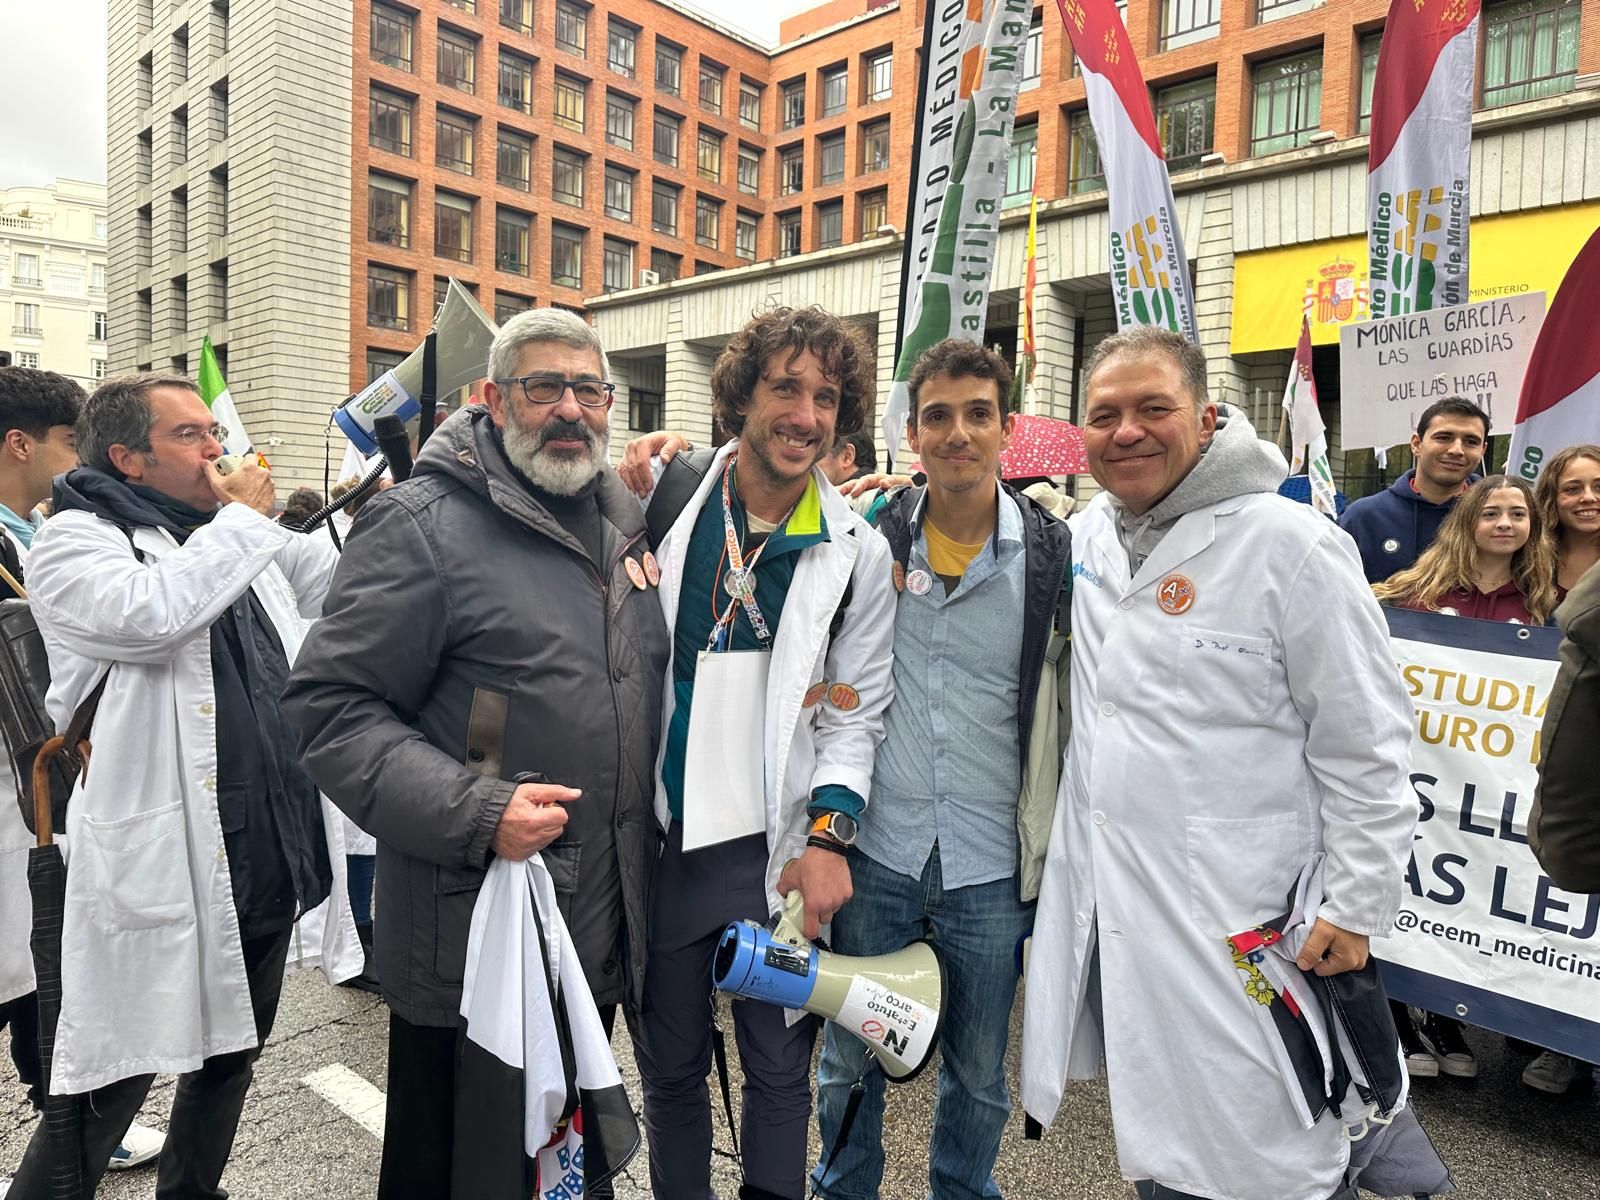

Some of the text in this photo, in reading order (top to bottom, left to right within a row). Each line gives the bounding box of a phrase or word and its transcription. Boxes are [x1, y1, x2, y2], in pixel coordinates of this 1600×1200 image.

[929, 0, 964, 147] MÉDICO
[960, 198, 995, 331] astilla
[978, 96, 1010, 138] La
[1159, 206, 1178, 271] Murcia
[1370, 191, 1392, 281] Médico
[1441, 179, 1464, 308] ión de Murcia
[1111, 231, 1132, 326] Médico
[1469, 283, 1529, 297] MINISTERIO
[1357, 317, 1431, 348] MÓNICA
[1379, 332, 1514, 366] LAS GUARDIAS
[1387, 371, 1498, 401] QUE LAS HAGA
[1415, 709, 1515, 758] URO
[1408, 773, 1529, 845] S LL
[1394, 909, 1600, 981] @ceem_medicina
[867, 1001, 917, 1032] Estatuto
